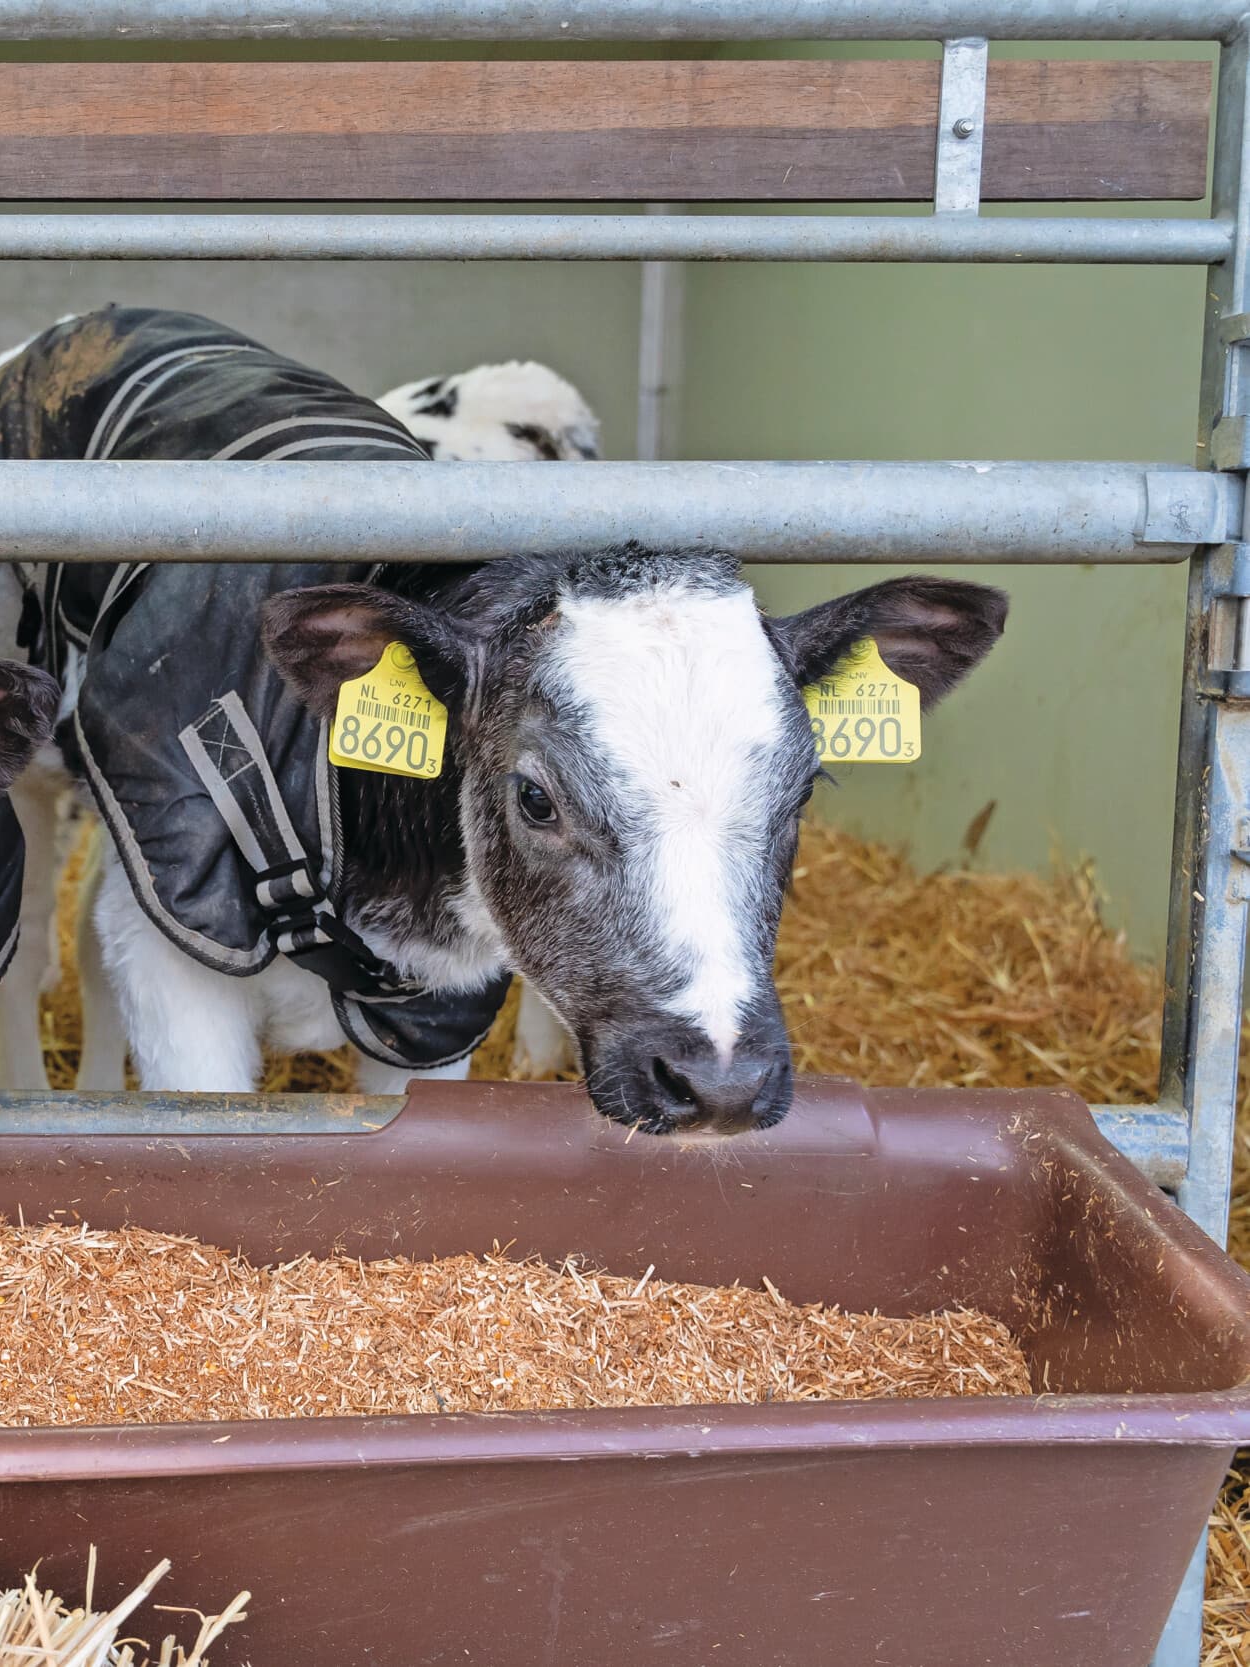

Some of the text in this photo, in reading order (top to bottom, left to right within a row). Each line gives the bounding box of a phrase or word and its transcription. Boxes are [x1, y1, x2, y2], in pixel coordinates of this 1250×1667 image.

[389, 679, 407, 688] LNV
[820, 682, 899, 697] NL 6271
[360, 683, 432, 713] NL 6271
